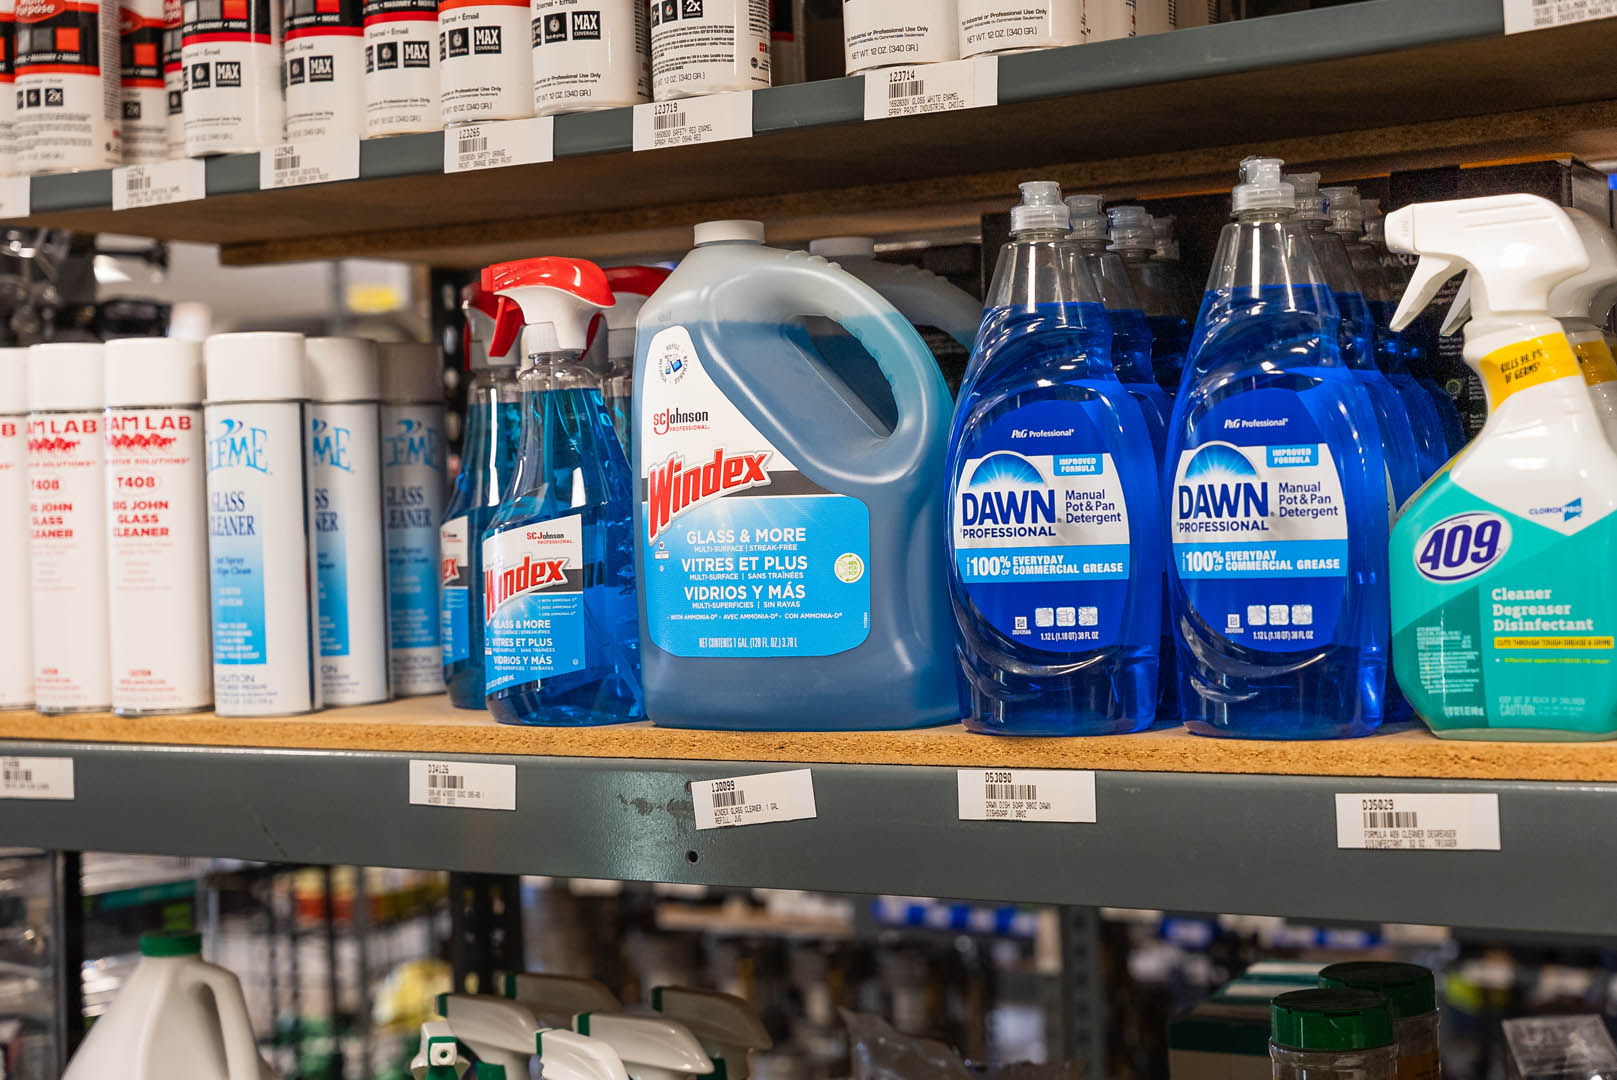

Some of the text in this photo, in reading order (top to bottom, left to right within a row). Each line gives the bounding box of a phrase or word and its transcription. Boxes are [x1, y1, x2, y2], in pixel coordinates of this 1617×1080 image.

[1035, 8, 1047, 16] Only
[574, 14, 597, 30] MAX
[476, 29, 499, 46] MAX
[988, 30, 994, 39] 12
[405, 44, 428, 60] MAX
[870, 46, 877, 55] 12
[217, 63, 240, 79] MAX
[311, 59, 332, 75] MAX
[889, 69, 915, 83] 123714
[654, 102, 678, 115] 123719
[459, 127, 480, 140] 123265
[653, 407, 709, 436] SCJohnson
[1241, 418, 1286, 429] Professional
[1029, 428, 1072, 439] Professional
[1272, 448, 1312, 458] IMPROVED
[1059, 457, 1097, 466] IMPROVED
[1274, 456, 1311, 465] FORMULA
[1061, 465, 1096, 474] FORMULA
[117, 476, 156, 489] T408
[1278, 481, 1321, 494] Manual
[649, 447, 768, 540] Windex
[1065, 489, 1105, 501] Manual
[1279, 493, 1332, 506] Pot & Pan
[133, 500, 169, 511] JOHN
[1065, 500, 1115, 512] Pot & Pan
[1178, 481, 1269, 521] DAWN
[962, 489, 1056, 527] DAWN
[1279, 505, 1339, 520] Detergent
[117, 513, 159, 524] GLASS
[1065, 511, 1122, 526] Detergent
[963, 525, 1057, 540] PROFESSIONAL
[1179, 519, 1270, 533] PROFESSIONAL
[526, 531, 564, 543] SCJohnson
[686, 527, 807, 545] GLASS & MORE
[749, 543, 798, 552] STREAK-FREE
[1419, 519, 1503, 571] 409
[681, 555, 808, 573] VITRES ET PLUS
[970, 554, 1064, 577] 100% EVERYDAY
[1185, 549, 1277, 573] 100% EVERYDAY
[1225, 557, 1341, 573] COMMERCIAL GREASE
[1013, 563, 1080, 576] COMMERCIAL
[1083, 561, 1124, 574] GREASE
[689, 573, 739, 582] MULTI-SURFACE
[747, 572, 767, 580] SANS
[684, 580, 807, 601] VIDRIOS Y MÁS
[1491, 586, 1553, 602] Cleaner
[692, 600, 801, 610] MULTI-SUPERFICIES SIN RAYAS
[1492, 603, 1573, 619] Degreaser
[523, 619, 552, 629] MORE
[1493, 617, 1595, 632] Disinfectant
[515, 638, 527, 647] ET
[528, 638, 553, 647] PLUS
[522, 656, 530, 665] Y
[531, 654, 553, 665] MÁS
[711, 780, 736, 793] 130099
